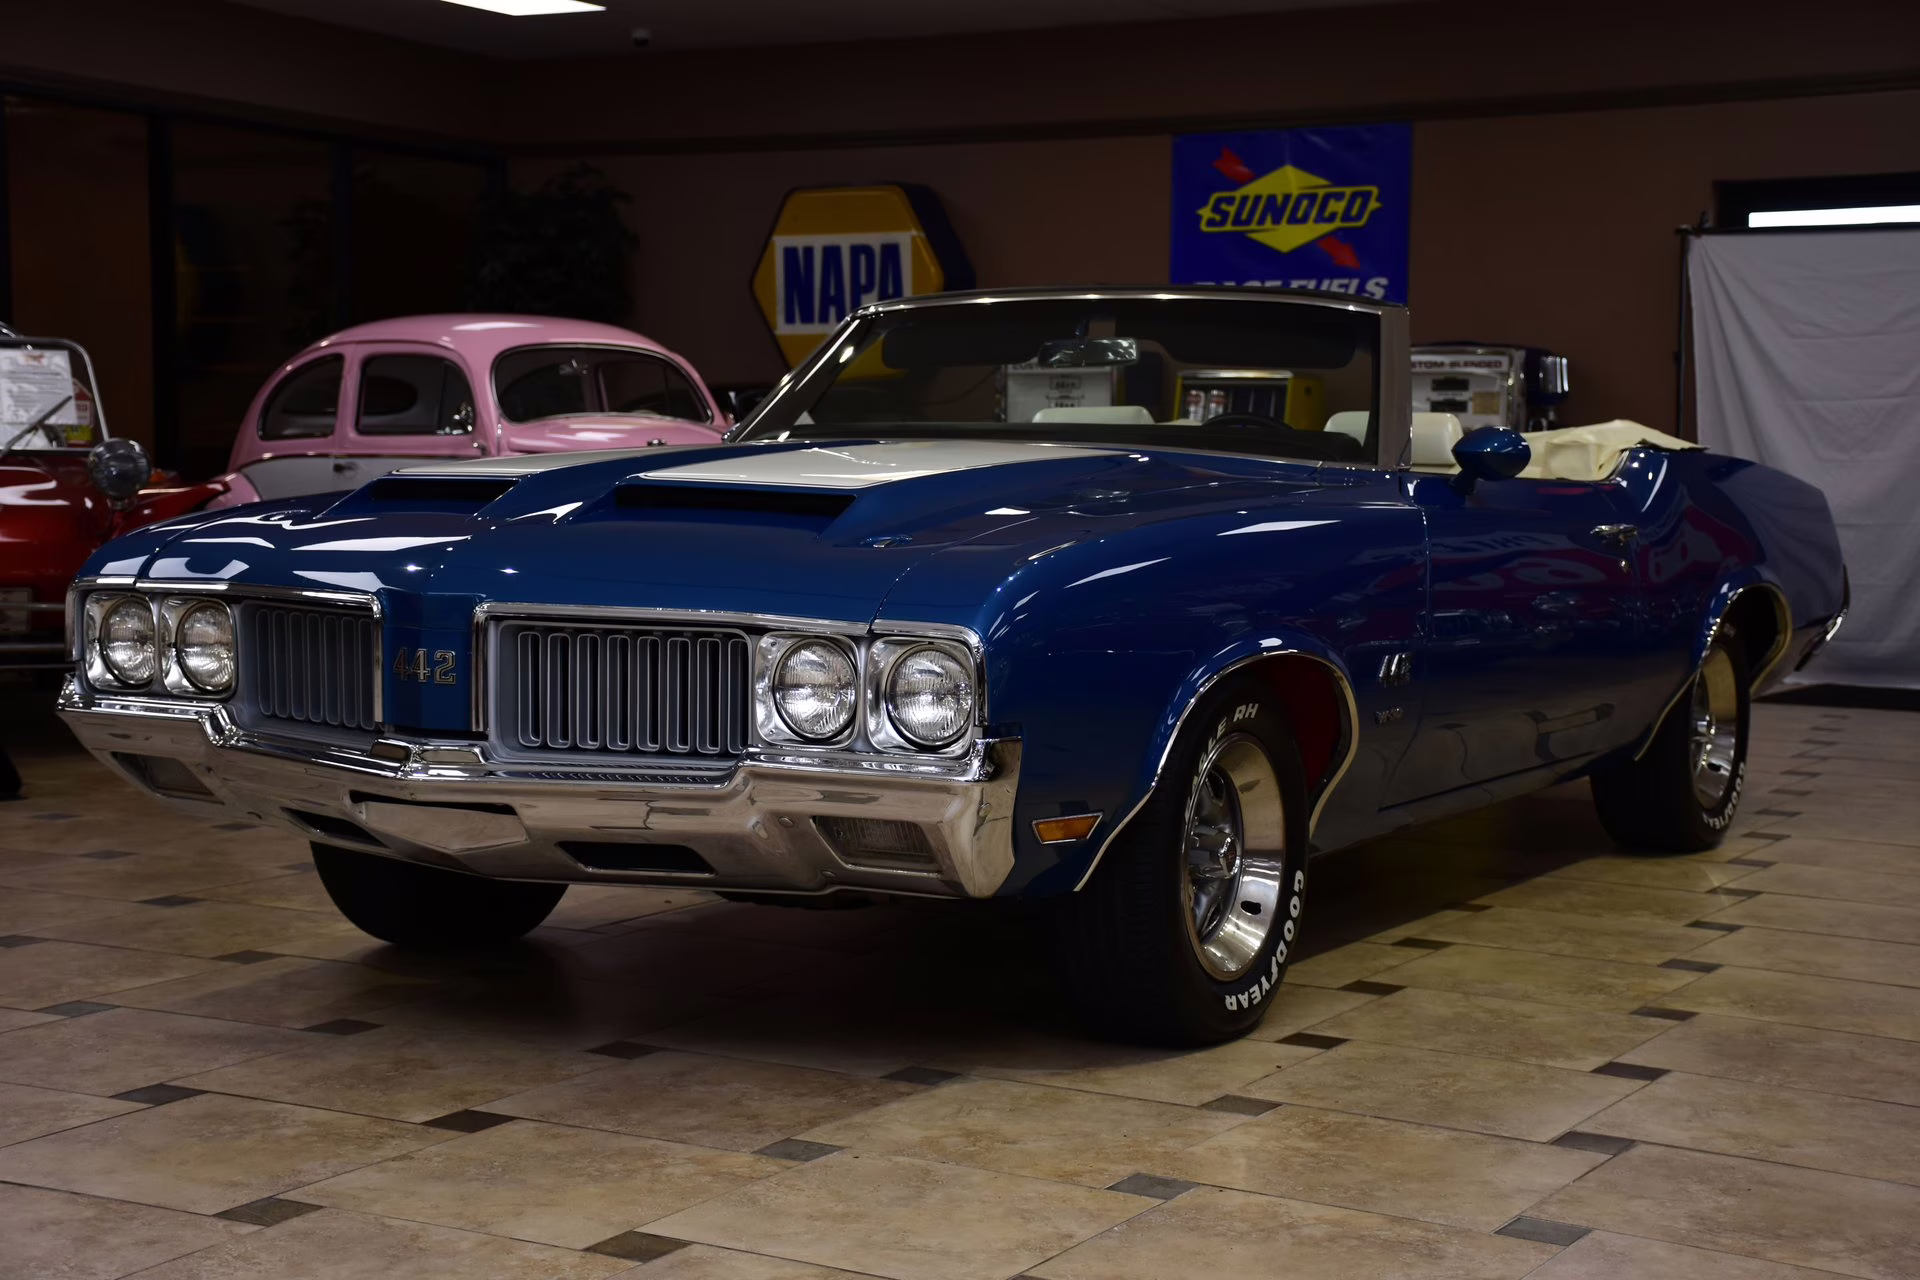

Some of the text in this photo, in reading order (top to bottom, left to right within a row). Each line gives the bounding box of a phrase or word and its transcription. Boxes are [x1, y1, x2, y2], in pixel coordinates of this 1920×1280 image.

[1205, 190, 1375, 228] SUNOCO
[782, 243, 904, 324] NAPA
[393, 646, 456, 685] 442
[1233, 703, 1260, 722] RH
[1224, 869, 1304, 1011] GOODYEAR
